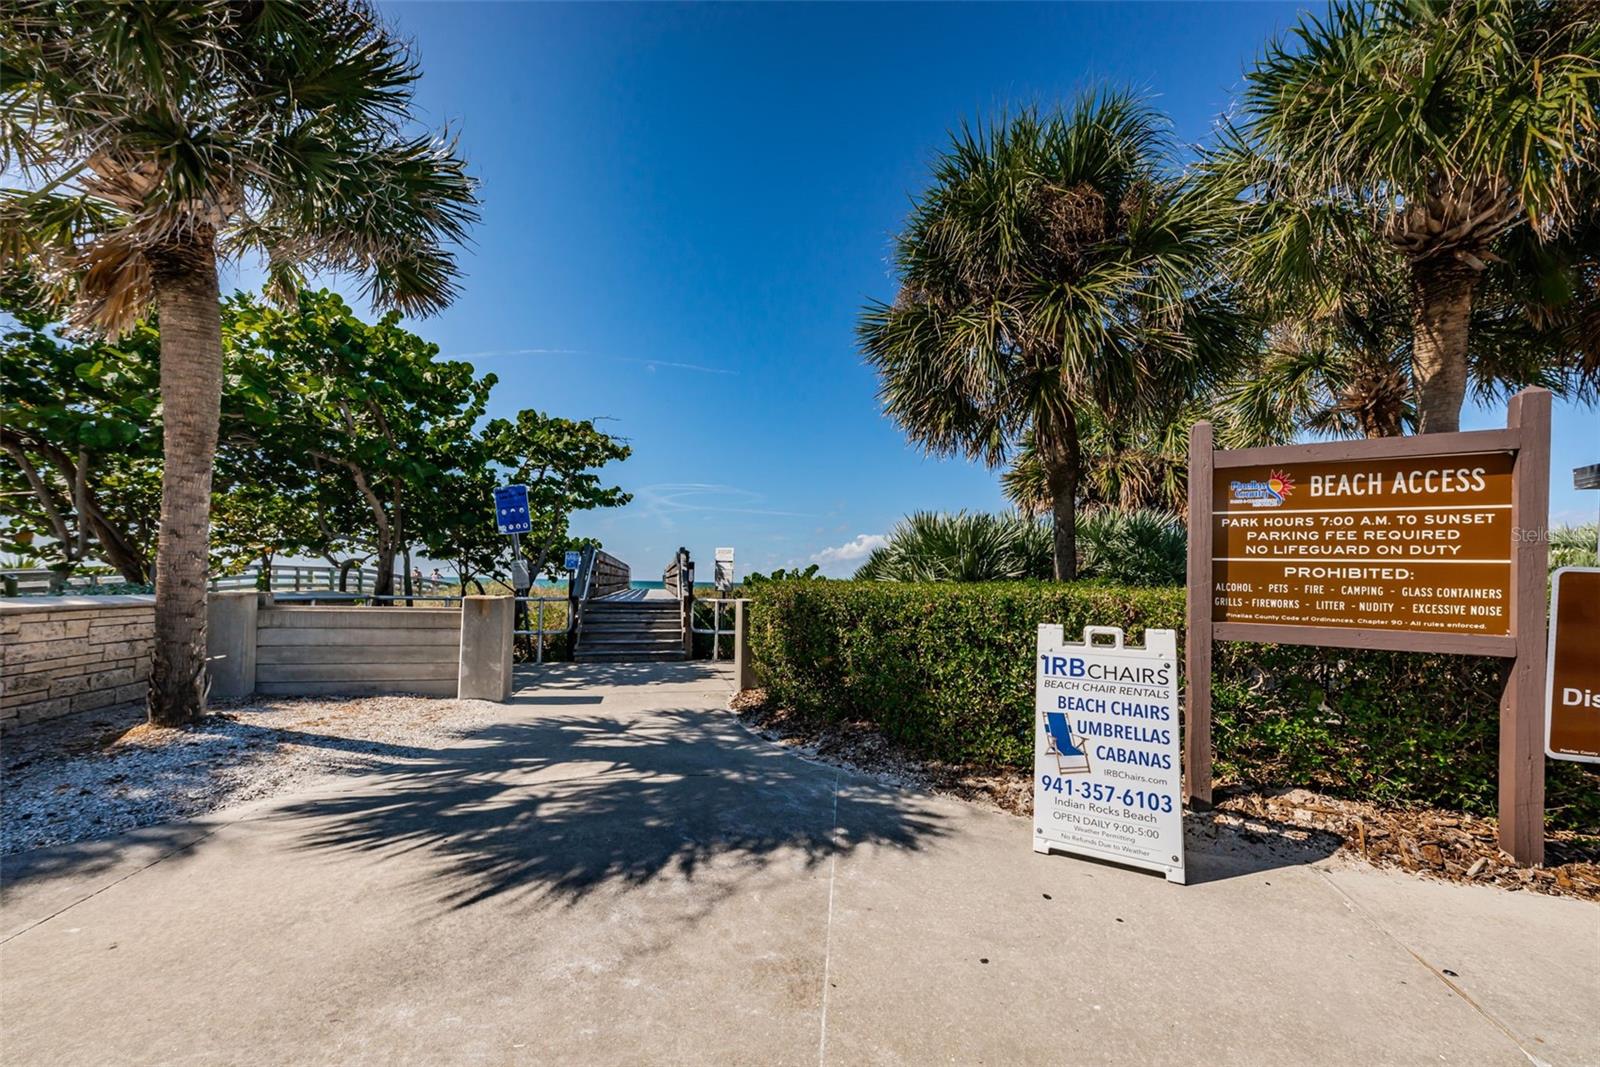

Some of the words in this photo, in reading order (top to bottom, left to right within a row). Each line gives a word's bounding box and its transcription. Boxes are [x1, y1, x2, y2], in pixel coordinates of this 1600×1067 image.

[1310, 472, 1382, 497] BEACH
[1391, 467, 1486, 494] ACCESS
[1221, 518, 1259, 527] PARK
[1264, 517, 1314, 527] HOURS
[1320, 516, 1354, 526] 7:00
[1360, 515, 1391, 526] A.M.
[1397, 515, 1417, 525] TO
[1424, 513, 1496, 525] SUNSET
[1247, 531, 1320, 541] PARKING
[1325, 530, 1358, 540] FEE
[1363, 530, 1461, 540] REQUIRED
[1245, 545, 1269, 555] NO
[1273, 545, 1370, 555] LIFEGUARD
[1376, 545, 1403, 555] ON
[1409, 545, 1462, 555] DUTY
[1284, 567, 1415, 580] PROHIBITED:
[1215, 582, 1254, 593] ALCOHOL
[1268, 584, 1289, 593] PETS
[1304, 584, 1325, 595] FIRE
[1341, 586, 1384, 596] CAMPING
[1401, 587, 1433, 597] GLASS
[1436, 588, 1503, 599] CONTAINERS
[1214, 597, 1243, 607] GRILLS
[1251, 598, 1300, 609] FIREWORKS
[1316, 600, 1346, 611] LITTER
[1359, 602, 1394, 613] NUDITY
[1412, 603, 1467, 615] EXCESSIVE
[1470, 605, 1503, 617] NOISE
[1254, 613, 1279, 621] County
[1446, 622, 1488, 630] enforced.
[1044, 679, 1080, 691] BEACH
[1082, 683, 1117, 694] CHAIR
[1119, 686, 1170, 700] RENTALS
[1057, 695, 1106, 714] BEACH
[1110, 700, 1170, 722] CHAIRS
[1077, 719, 1171, 746] UMBRELLAS
[1096, 745, 1172, 771] CABANAS
[1103, 768, 1168, 787] IRBChairs.com
[1041, 774, 1173, 814] 941-357-6103
[1054, 796, 1086, 811] Indian
[1088, 802, 1120, 818] Rocks
[1123, 808, 1158, 824] Beach
[1053, 811, 1080, 824] OPEN
[1083, 816, 1111, 830] DAILY
[1113, 822, 1160, 840] 9:00-5:00
[1073, 825, 1100, 836] Weather
[1101, 831, 1136, 844] Permitting
[1061, 832, 1071, 840] No
[1071, 835, 1097, 846] Refunds
[1098, 839, 1112, 849] Due
[1121, 845, 1150, 857] Weather
